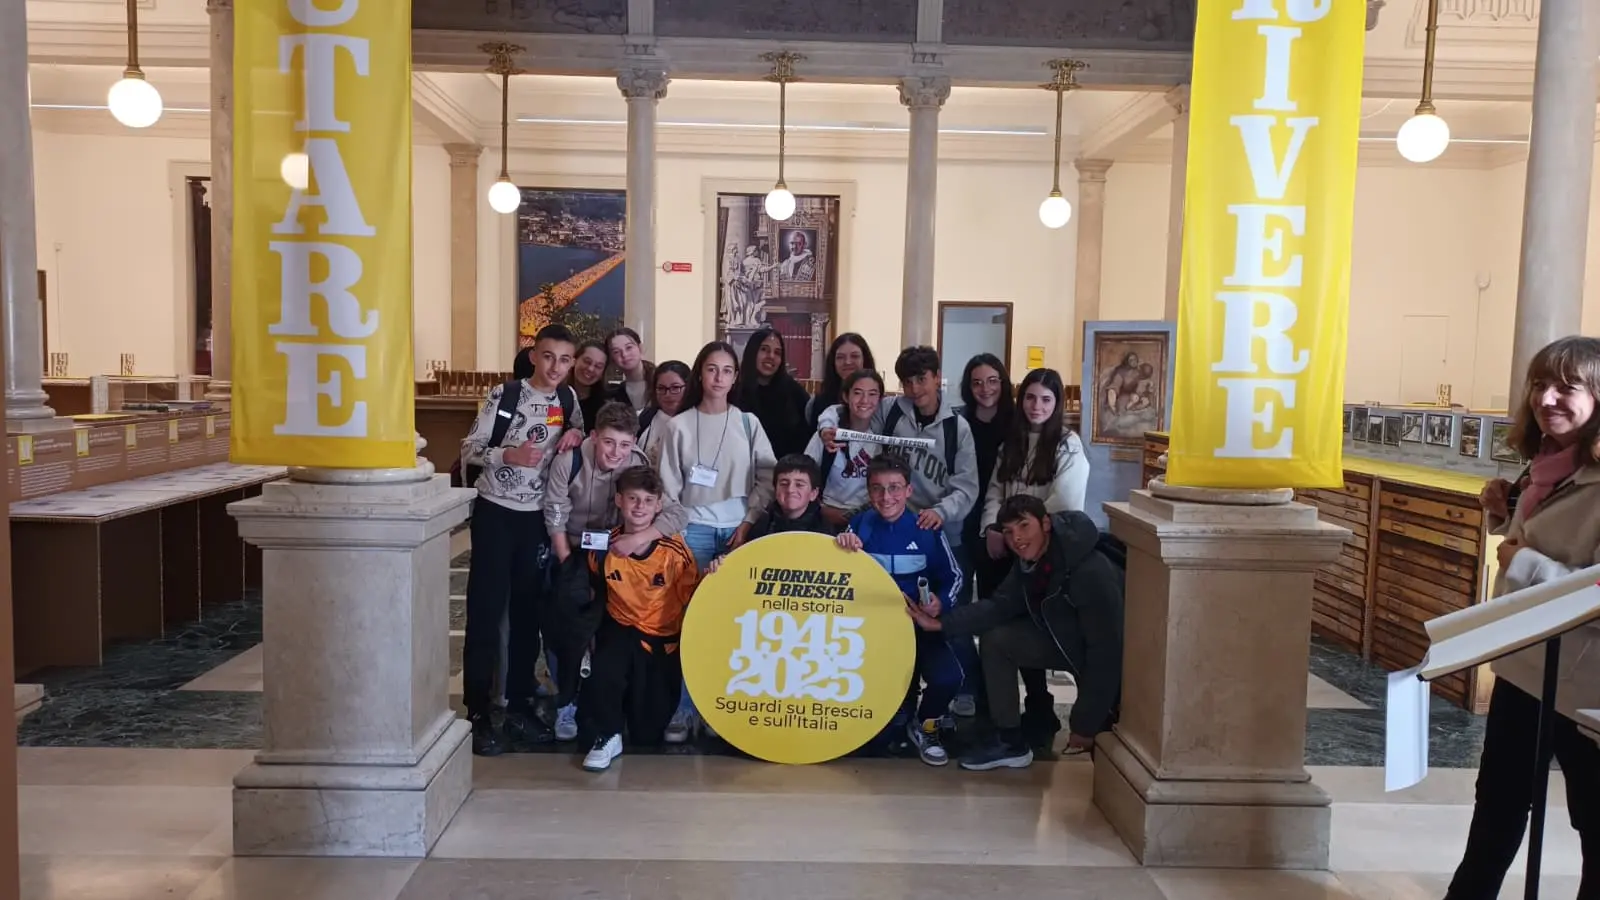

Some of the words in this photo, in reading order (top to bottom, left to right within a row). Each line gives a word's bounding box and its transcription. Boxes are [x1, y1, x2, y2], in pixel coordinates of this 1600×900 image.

[267, 0, 378, 438] TARE
[1211, 0, 1332, 459] IVERE
[749, 567, 758, 580] Il
[760, 567, 852, 586] GIORNALE
[754, 581, 775, 595] DI
[778, 583, 855, 601] BRESCIA
[762, 598, 799, 611] nella
[802, 600, 844, 614] storia
[734, 610, 866, 669] 1945
[726, 649, 865, 702] 2025
[715, 696, 782, 714] Sguardi
[787, 704, 806, 715] su
[812, 703, 873, 719] Brescia
[748, 716, 759, 726] e
[763, 714, 838, 731] sull'Italia
